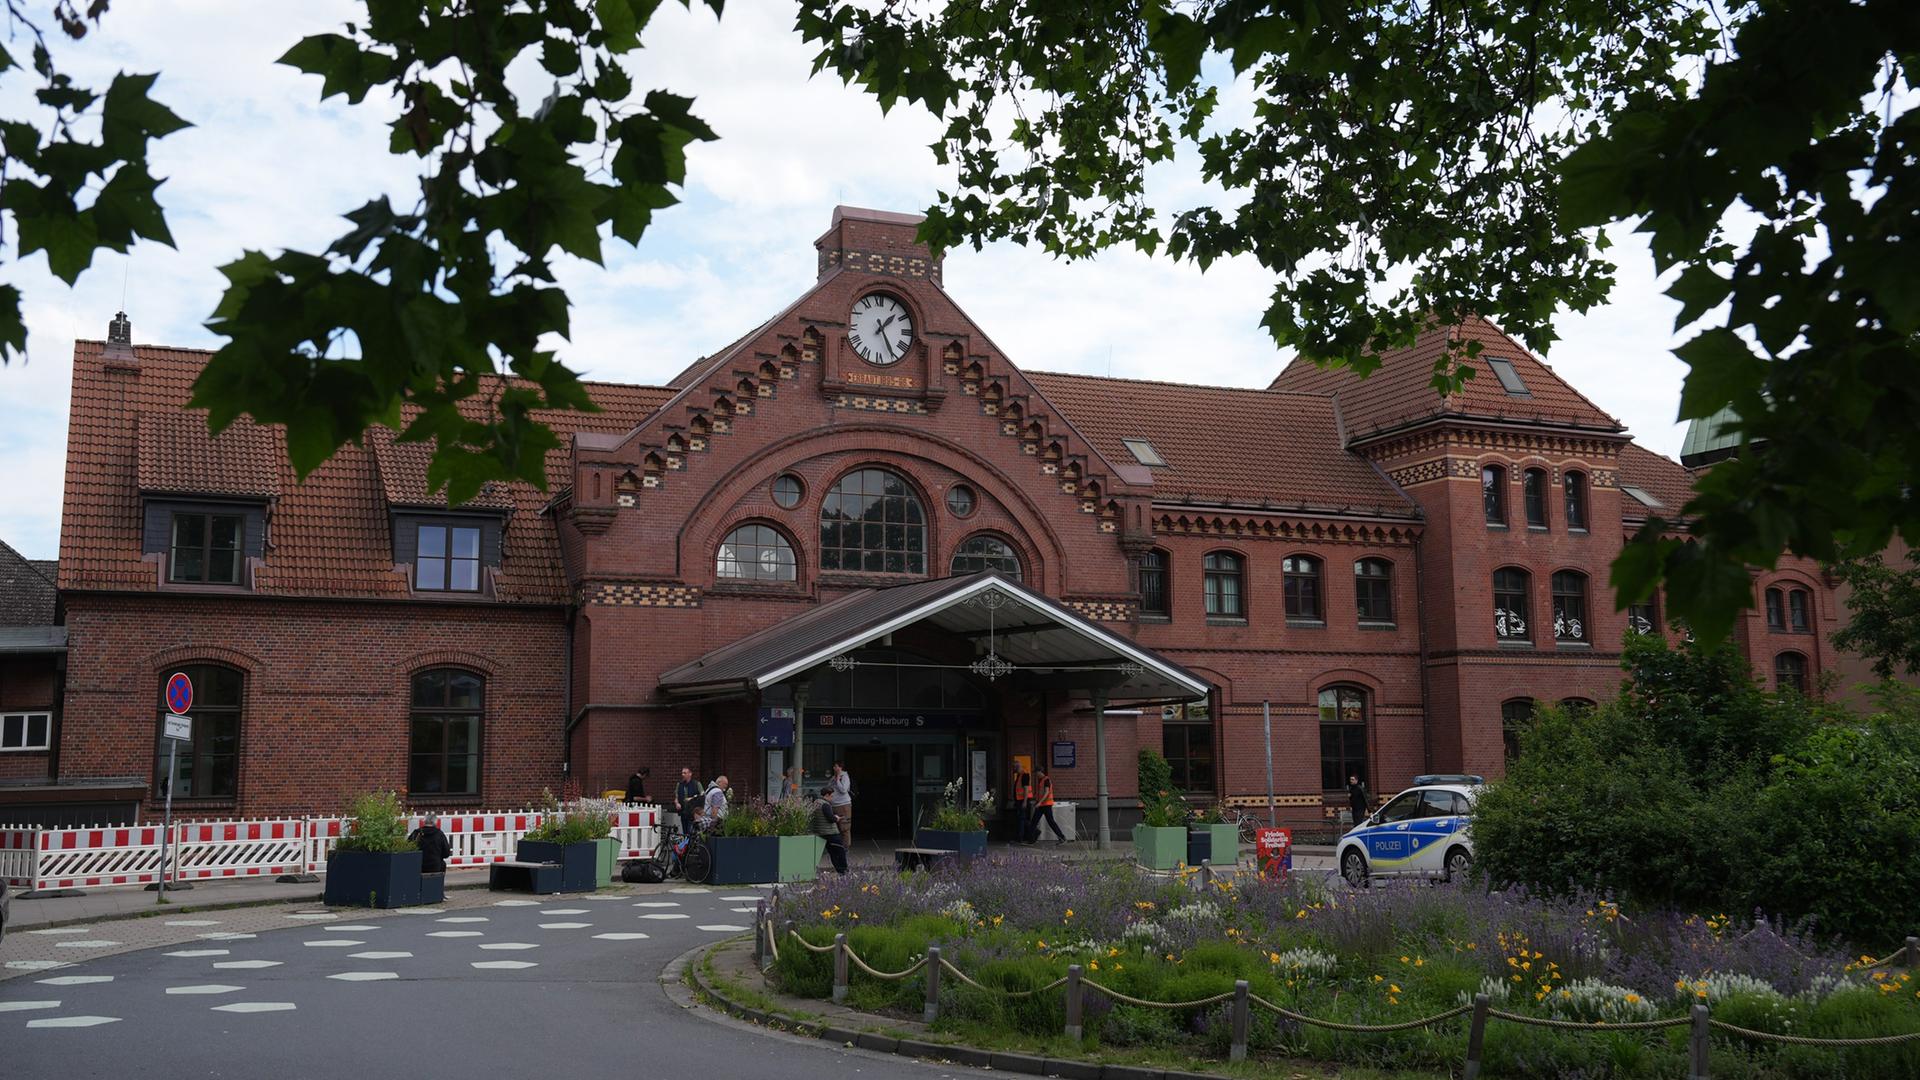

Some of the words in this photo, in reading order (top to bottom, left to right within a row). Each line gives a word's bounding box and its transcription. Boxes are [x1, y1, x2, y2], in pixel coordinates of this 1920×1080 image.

[820, 715, 833, 725] DB
[840, 715, 909, 727] Hamburg-Harburg
[1376, 840, 1402, 851] POLIZEI
